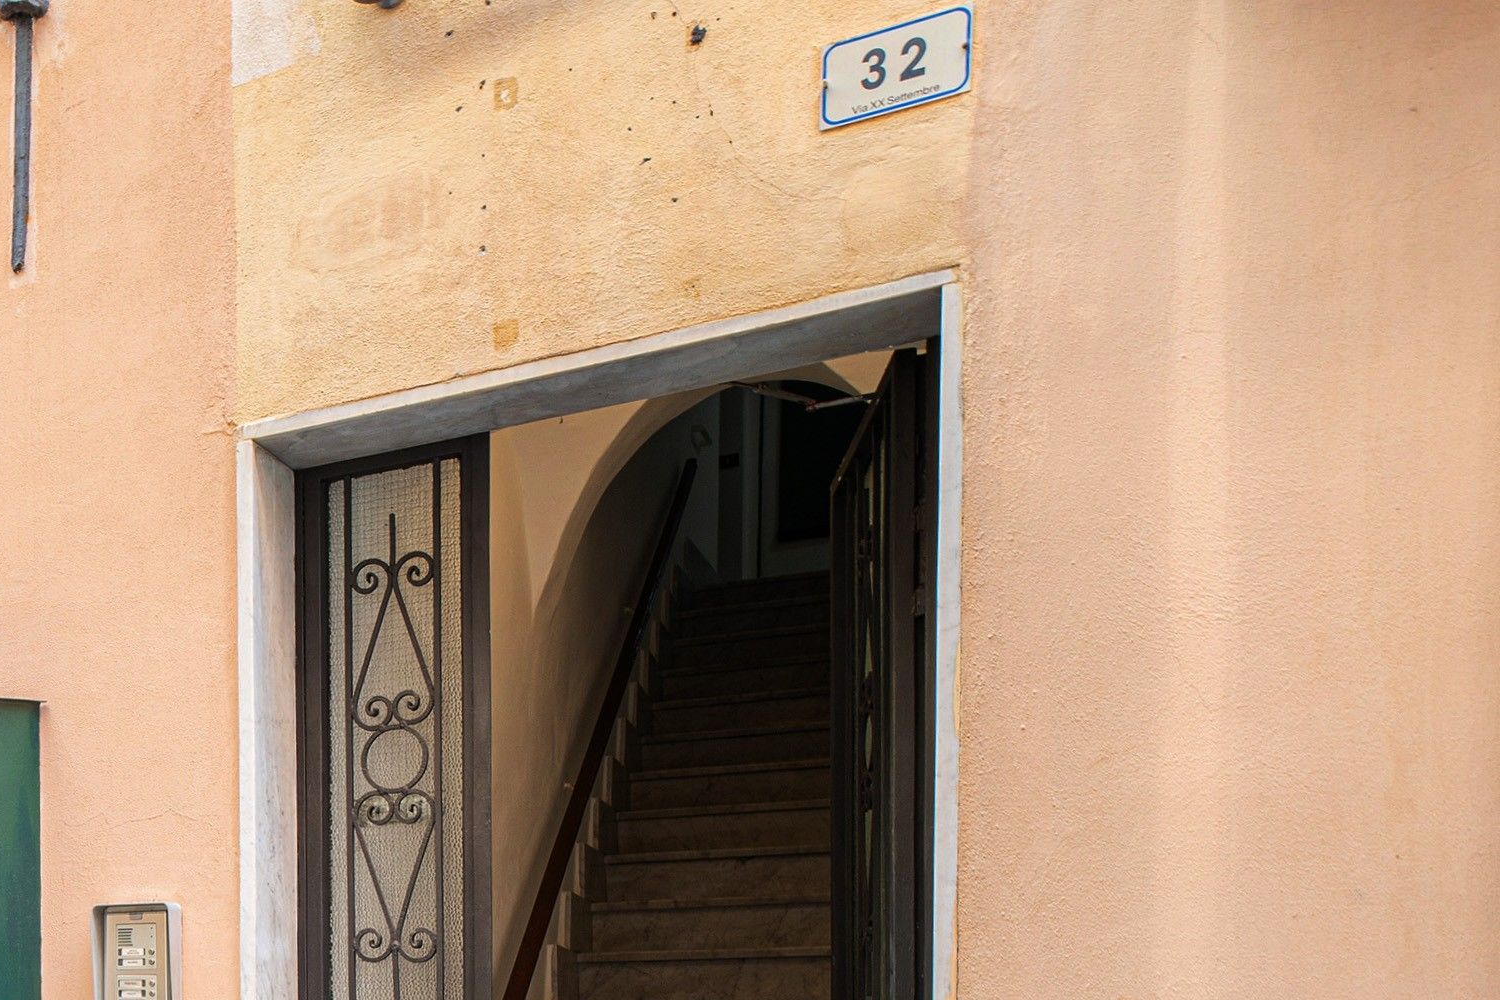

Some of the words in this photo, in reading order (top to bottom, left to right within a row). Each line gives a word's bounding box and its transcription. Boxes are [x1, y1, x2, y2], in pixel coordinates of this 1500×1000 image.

[861, 36, 927, 90] 32
[851, 103, 868, 114] Via
[868, 98, 887, 109] XX
[887, 84, 940, 103] Settembre
